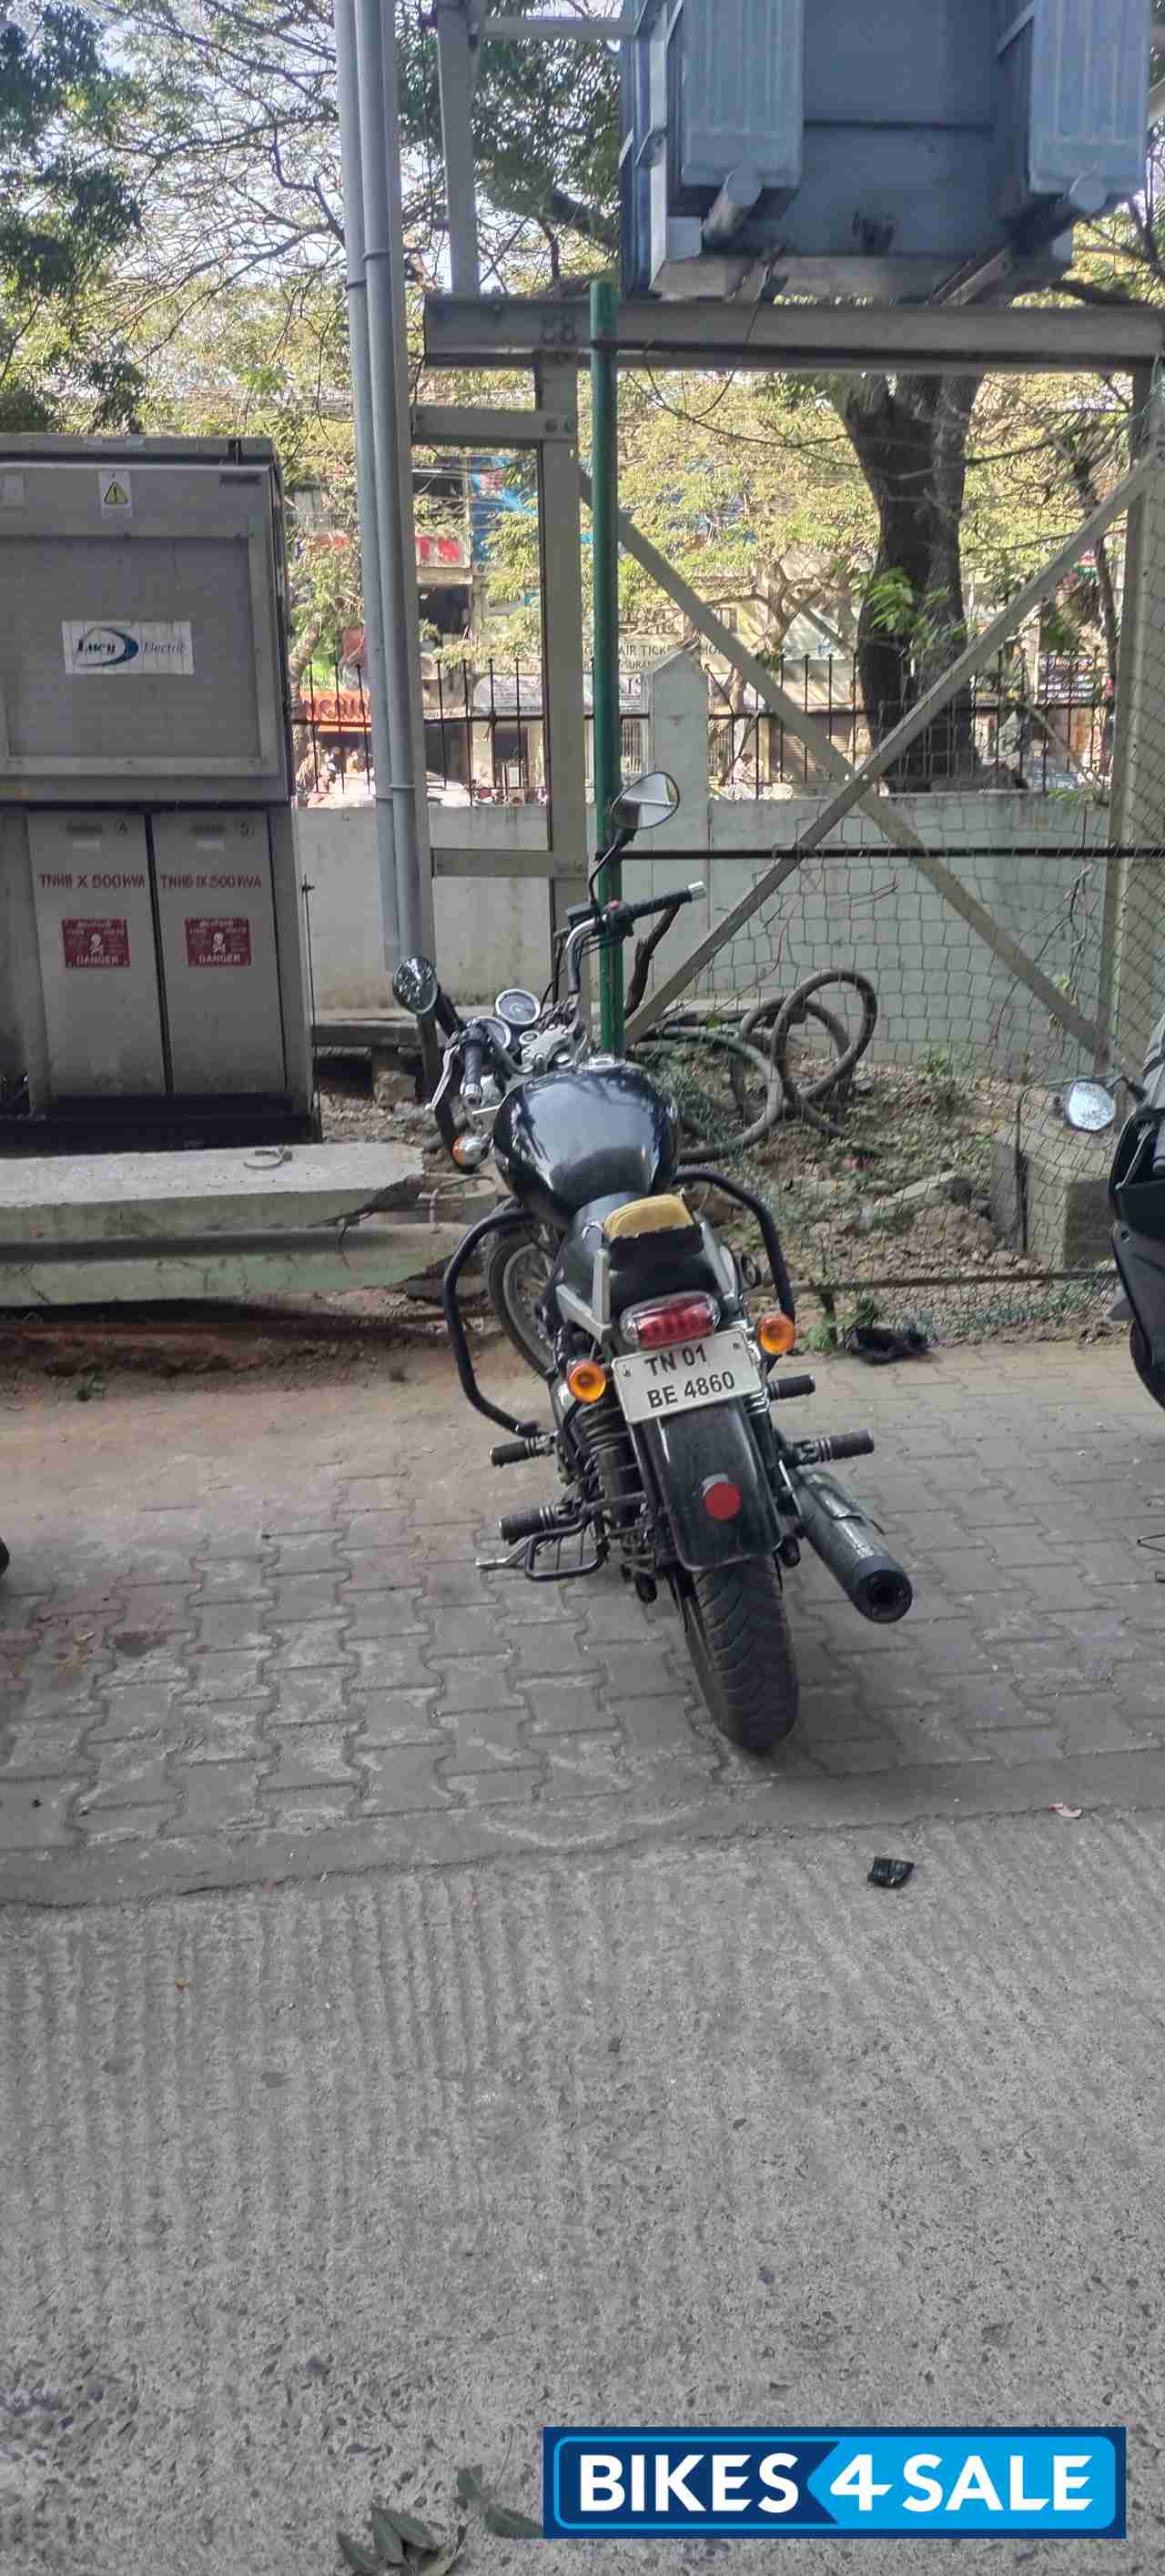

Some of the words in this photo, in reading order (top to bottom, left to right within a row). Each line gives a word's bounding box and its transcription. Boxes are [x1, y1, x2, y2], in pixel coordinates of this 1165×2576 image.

[75, 639, 116, 656] Lucy
[76, 954, 119, 965] DANGER
[198, 953, 241, 964] DANGER
[644, 1351, 677, 1377] TN
[683, 1344, 707, 1367] 01
[647, 1385, 678, 1409] BE
[684, 1370, 735, 1399] 4860
